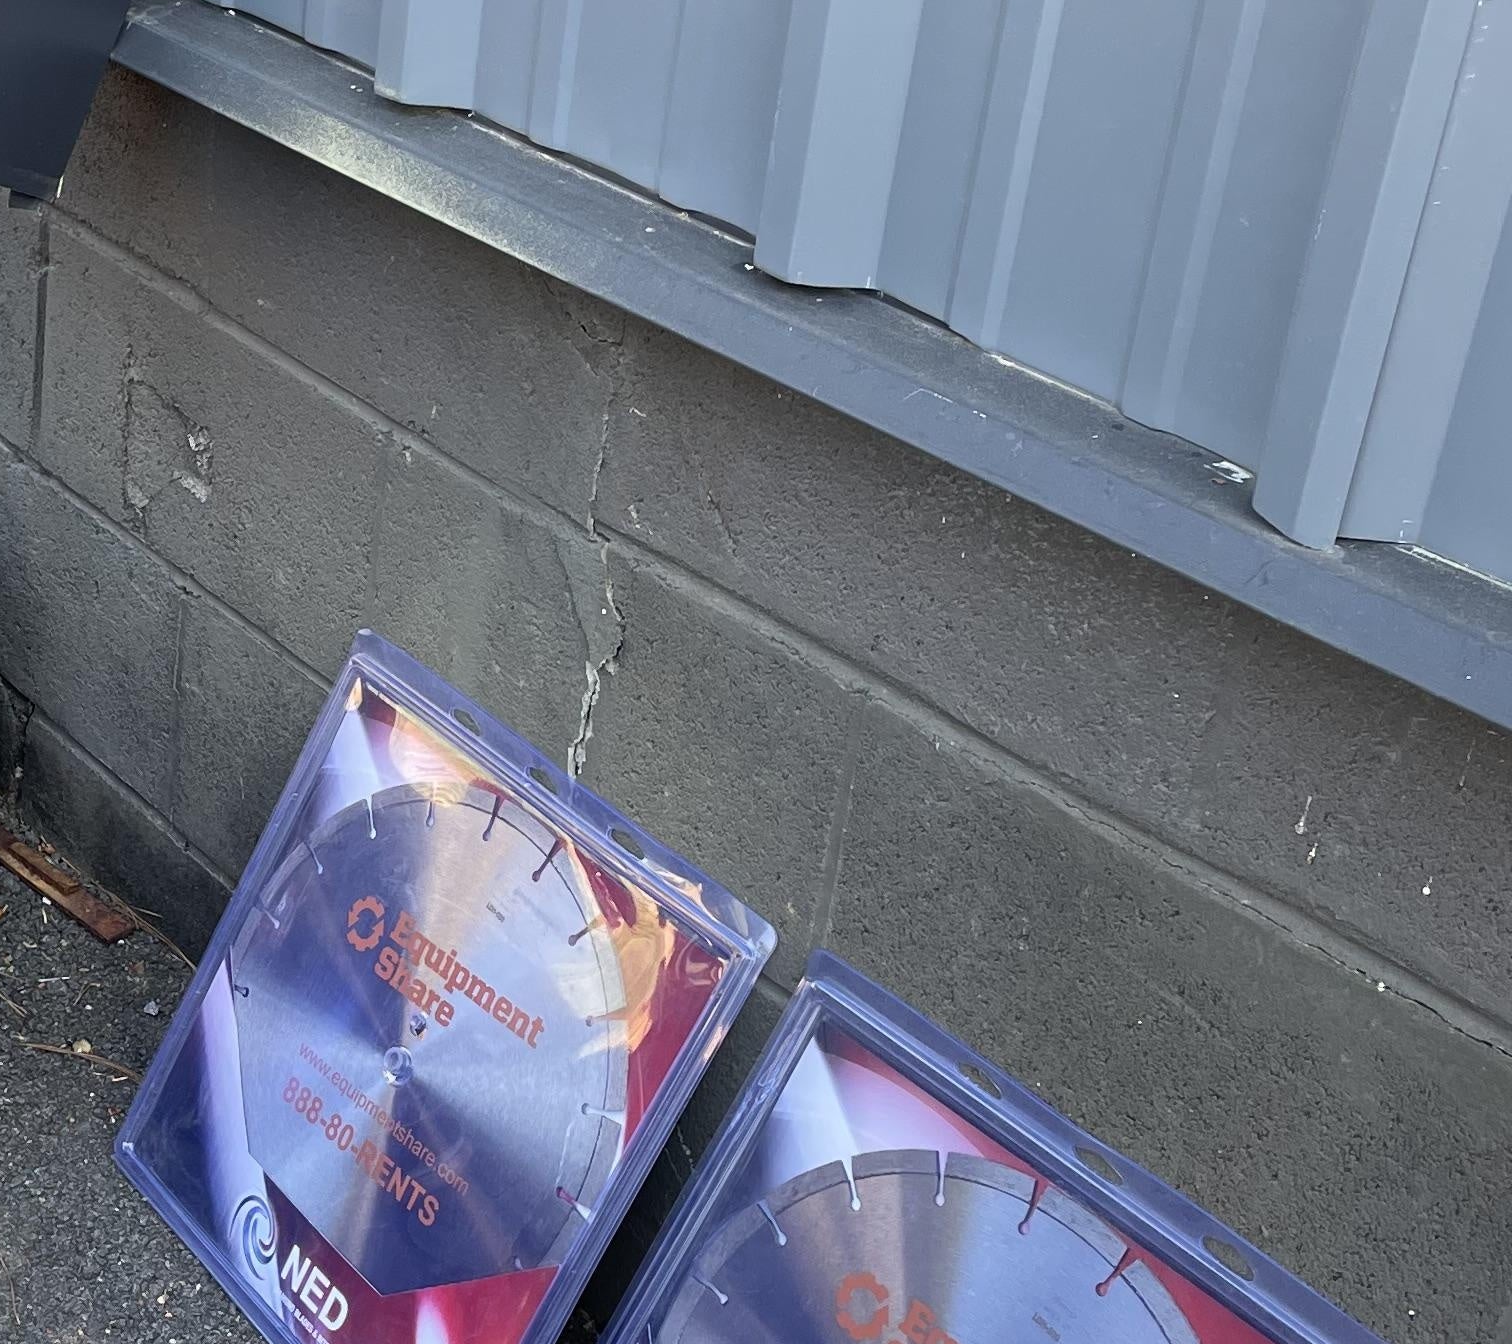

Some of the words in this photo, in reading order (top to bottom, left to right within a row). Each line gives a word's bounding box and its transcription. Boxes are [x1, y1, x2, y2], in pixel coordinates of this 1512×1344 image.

[374, 946, 455, 1027] Share
[390, 910, 545, 1049] Equipment
[283, 1076, 440, 1227] 888-80-RENTS
[299, 1042, 470, 1196] www.equipmentshare.com
[280, 1244, 348, 1331] NED
